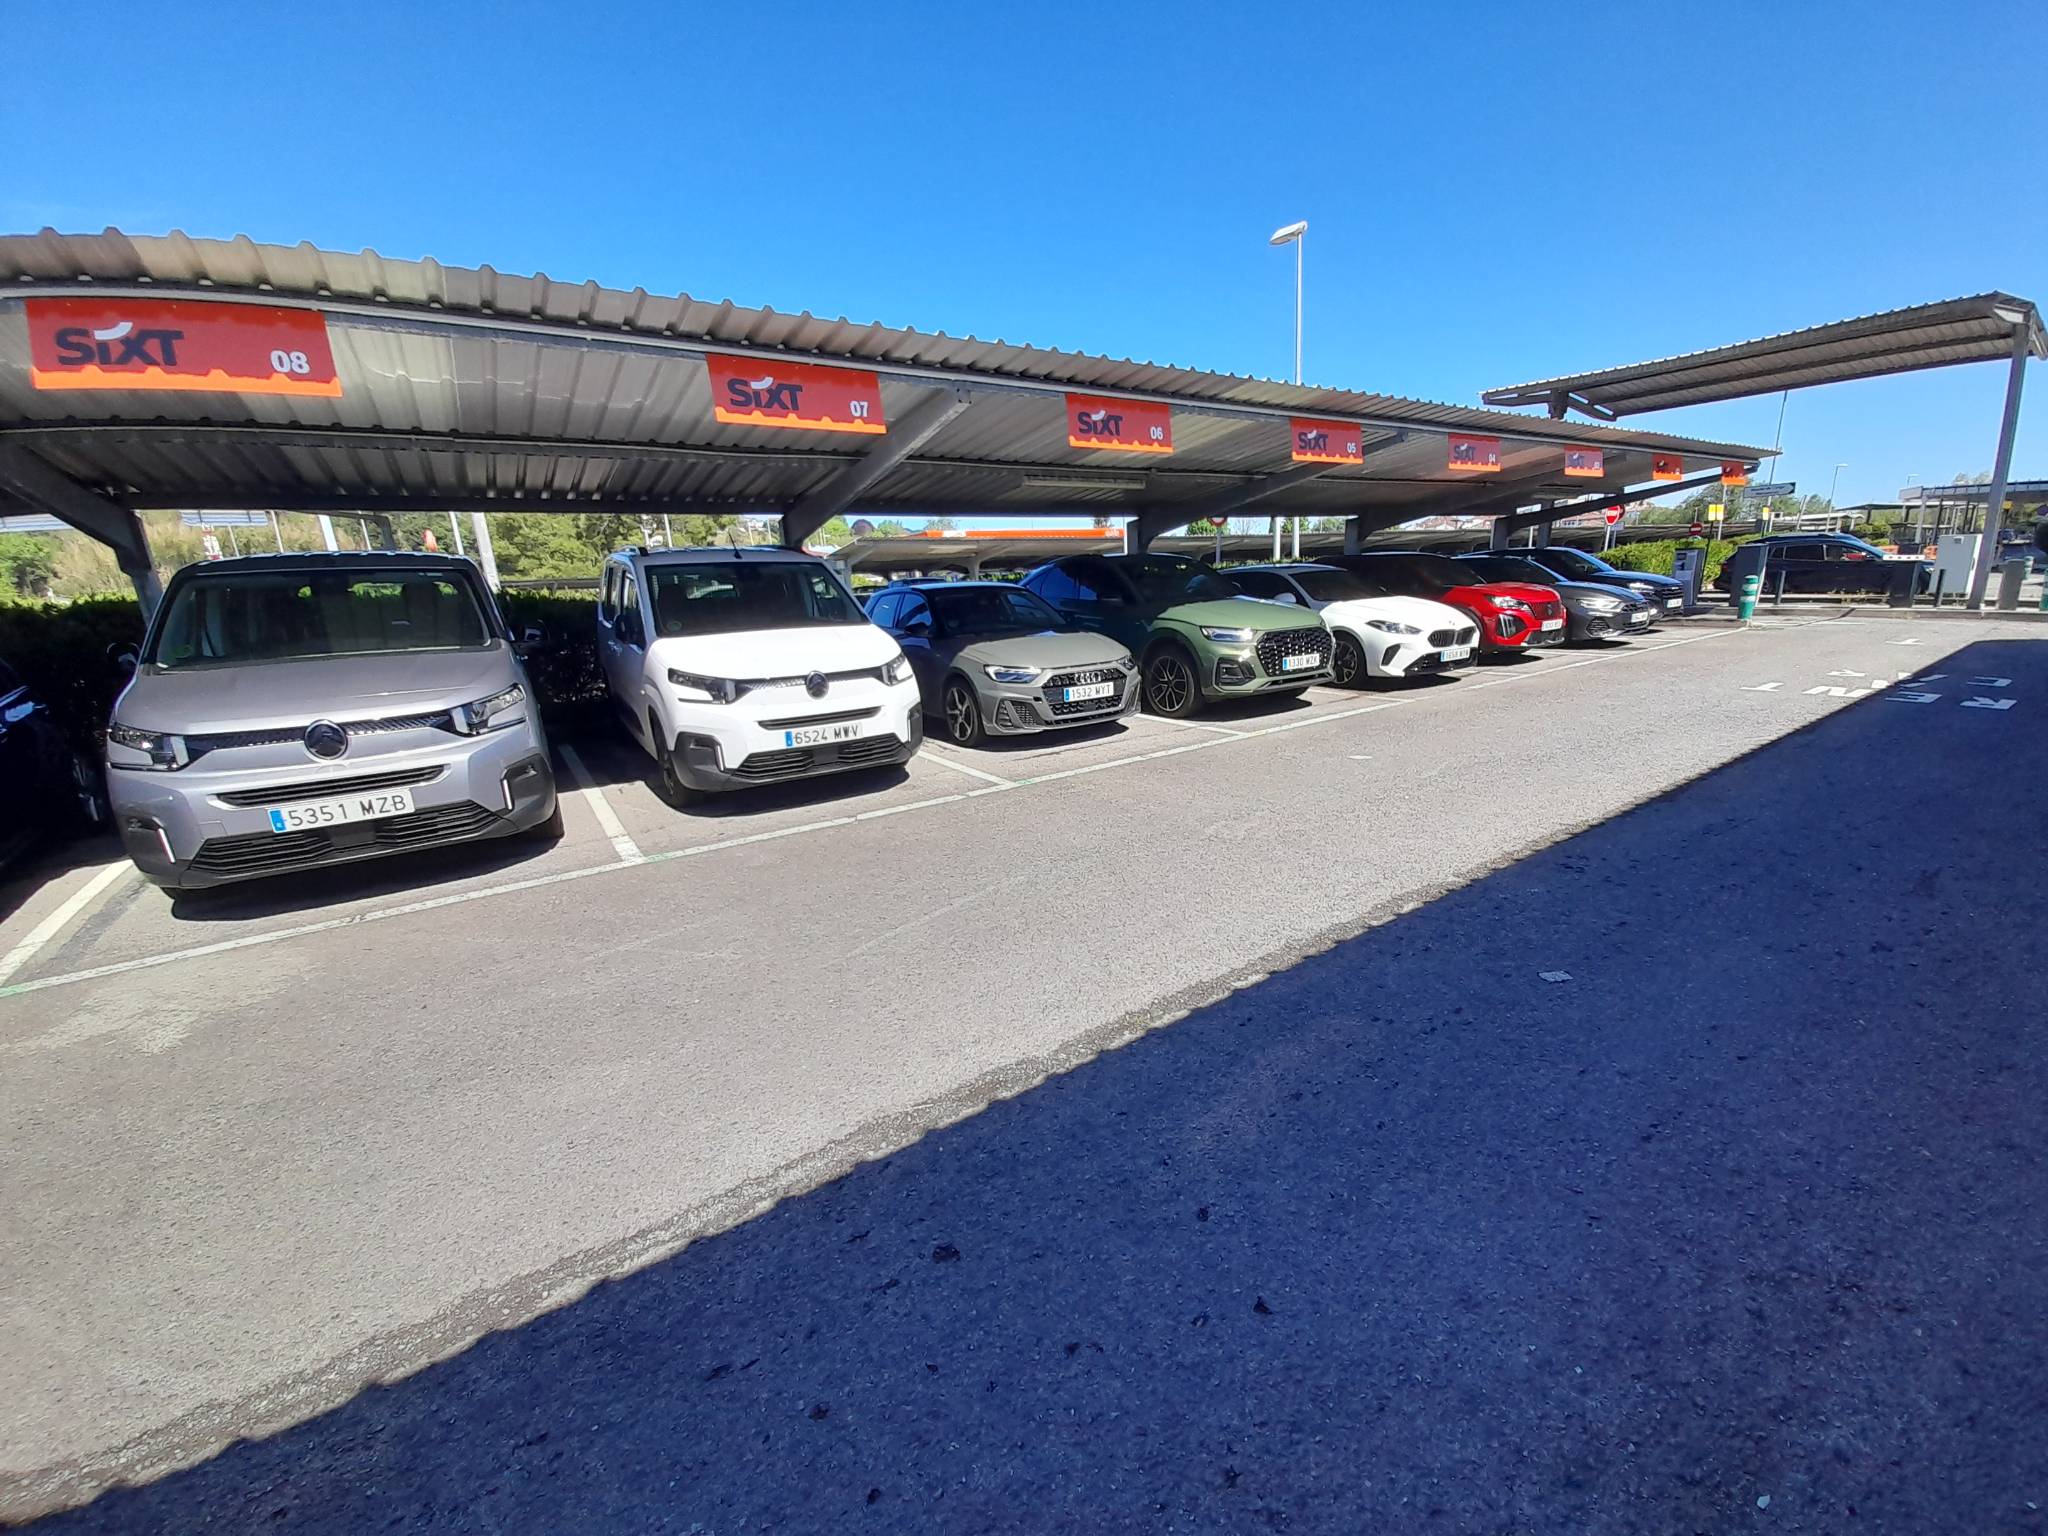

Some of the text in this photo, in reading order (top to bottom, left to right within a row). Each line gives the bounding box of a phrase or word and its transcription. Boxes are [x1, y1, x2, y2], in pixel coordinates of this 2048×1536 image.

[55, 322, 310, 374] SIXT 08
[727, 376, 868, 417] SIXT 07
[1078, 410, 1164, 440] SIXT 06
[1347, 442, 1357, 454] 05
[1072, 686, 1092, 700] 1532
[794, 725, 858, 745] 6524 MWV
[288, 794, 407, 827] 5351 MZB
